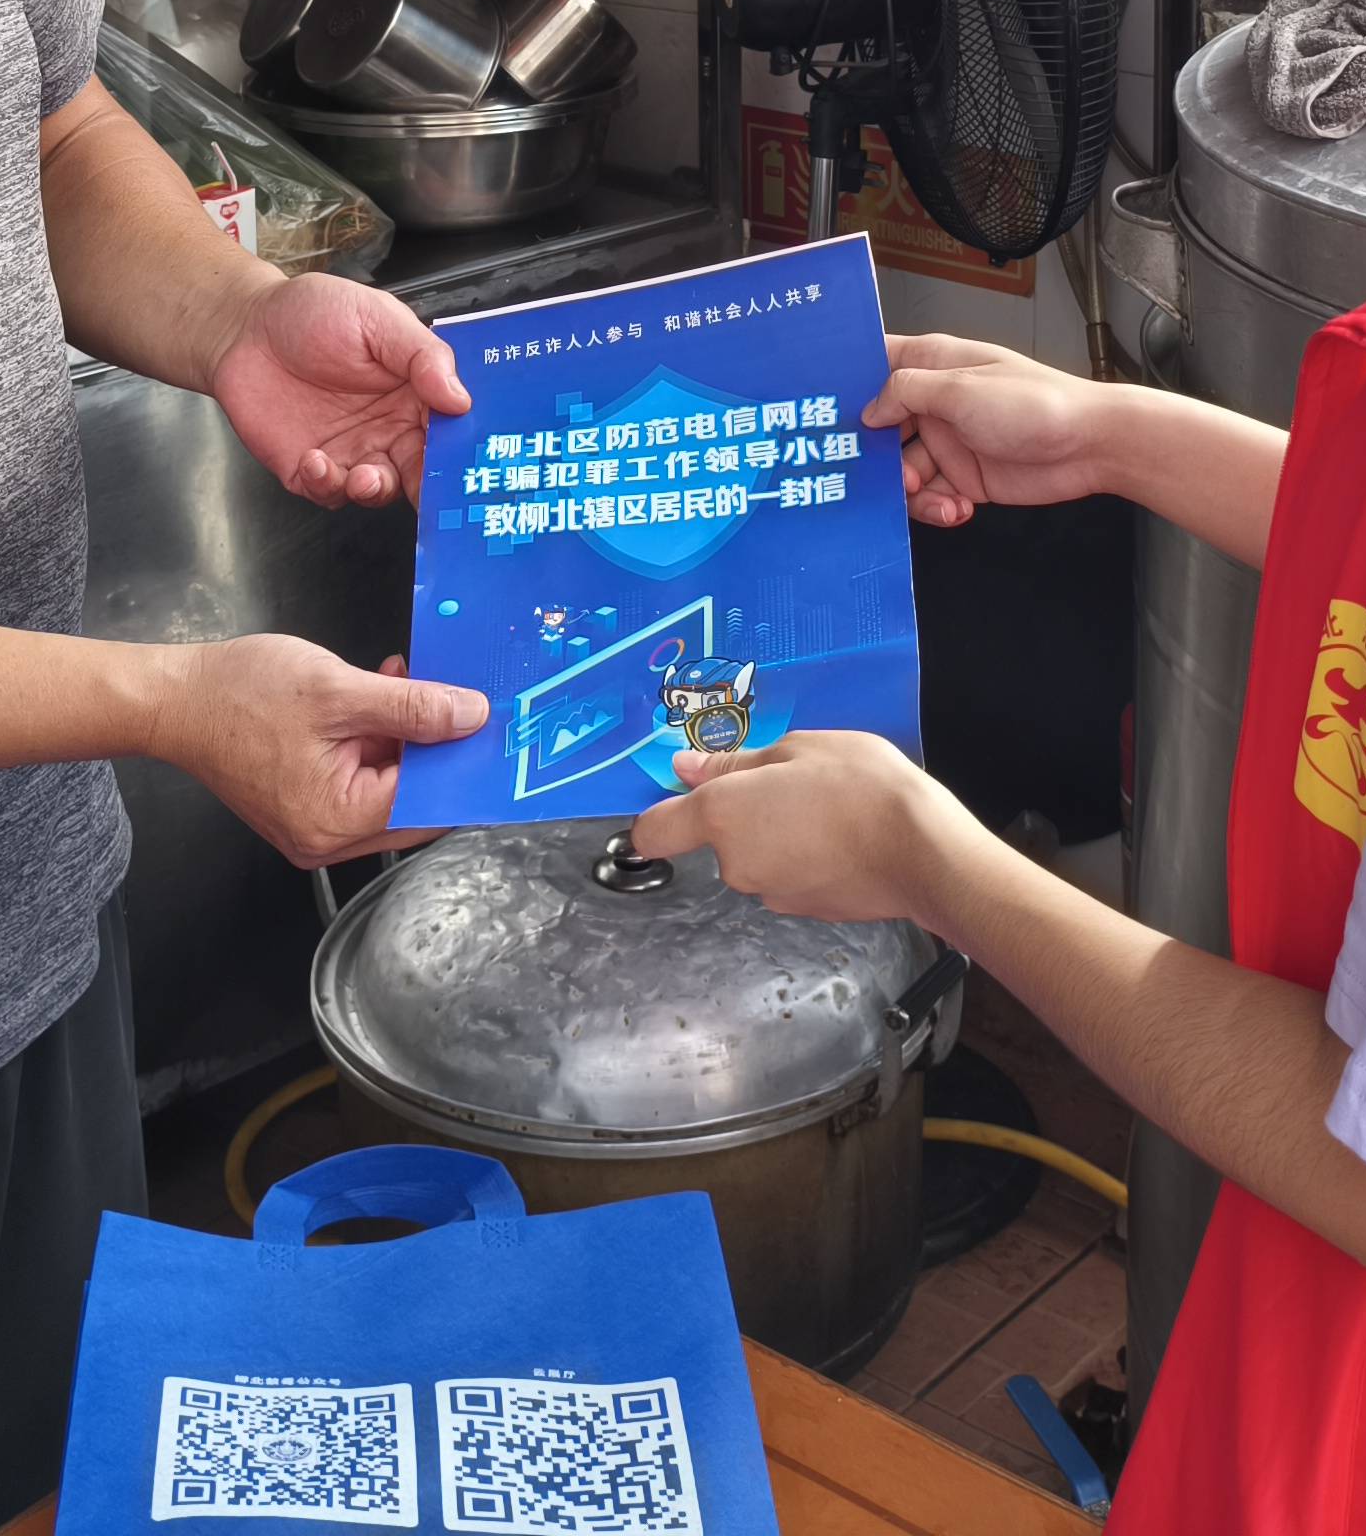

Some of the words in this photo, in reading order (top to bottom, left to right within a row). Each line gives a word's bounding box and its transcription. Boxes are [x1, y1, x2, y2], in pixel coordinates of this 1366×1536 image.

[484, 322, 643, 365] 防诈反诈人人参与
[664, 283, 823, 333] 和谐社会人人共享
[485, 395, 839, 462] 柳北区防范电信网络
[462, 431, 862, 496] 诈骗犯罪工作领导小组
[482, 472, 847, 538] 致柳北辖区居民的一封信
